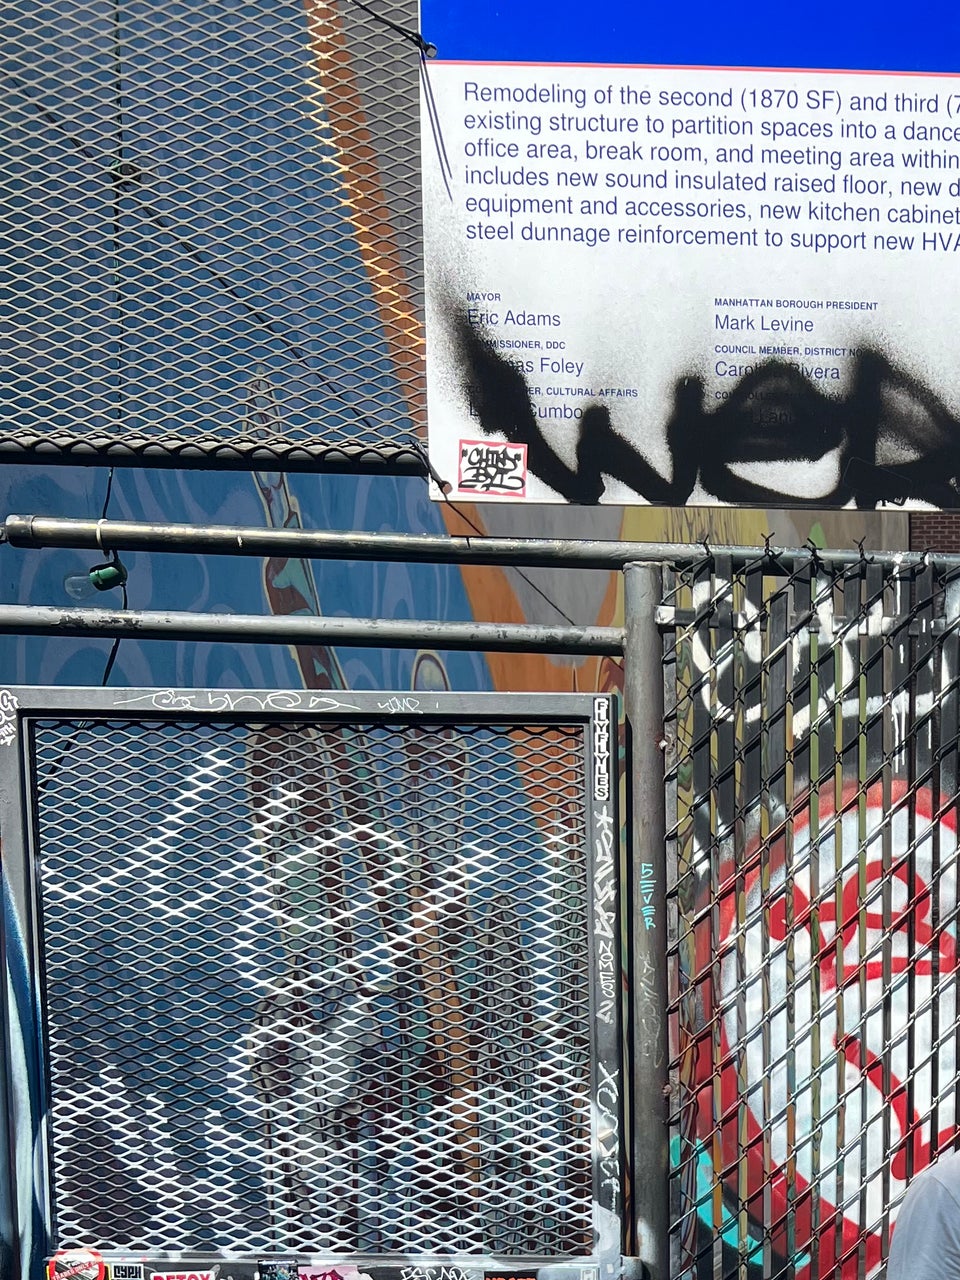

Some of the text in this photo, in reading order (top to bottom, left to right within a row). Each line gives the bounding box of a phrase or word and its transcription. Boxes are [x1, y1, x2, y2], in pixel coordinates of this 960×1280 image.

[465, 82, 586, 108] Remodeling
[594, 85, 612, 104] of
[620, 85, 651, 105] the
[659, 88, 732, 107] second
[741, 88, 798, 112] (1870
[806, 90, 841, 115] SF)
[850, 92, 887, 111] and
[894, 93, 938, 113] third
[464, 110, 541, 135] existing
[549, 113, 638, 133] structure
[646, 115, 664, 133] to
[672, 115, 752, 138] partition
[761, 121, 833, 141] spaces
[841, 118, 876, 139] into
[884, 125, 896, 140] a
[465, 138, 519, 158] office
[527, 144, 577, 162] area,
[586, 140, 643, 160] break
[651, 146, 707, 165] room,
[716, 144, 753, 163] and
[762, 146, 841, 170] meeting
[850, 152, 894, 167] area
[902, 149, 959, 169] within
[466, 165, 549, 186] includes
[557, 172, 598, 187] new
[605, 169, 667, 189] sound
[675, 170, 766, 191] insulated
[775, 173, 835, 193] raised
[843, 174, 892, 198] floor,
[901, 181, 942, 196] new
[466, 193, 573, 218] equipment
[580, 196, 617, 215] and
[625, 198, 751, 221] accessories,
[761, 205, 801, 219] new
[809, 201, 879, 222] kitchen
[466, 221, 513, 240] steel
[521, 221, 610, 247] dunnage
[618, 224, 758, 246] reinforcement
[764, 229, 783, 247] to
[791, 232, 866, 253] support
[874, 235, 914, 250] new
[467, 291, 501, 301] MAYOR
[715, 298, 878, 310] MANHATTAN BOROUGH PRESIDENT
[467, 309, 560, 326] Eric Adams
[716, 314, 813, 332] Mark Levine
[546, 340, 565, 349] DDC
[714, 345, 756, 354] COUNCIL
[759, 346, 802, 356] MEMBER,
[805, 347, 846, 356] DISTRICT
[540, 357, 584, 377] Foley
[546, 387, 596, 397] CULTURAL
[598, 388, 638, 398] AFFAIRS
